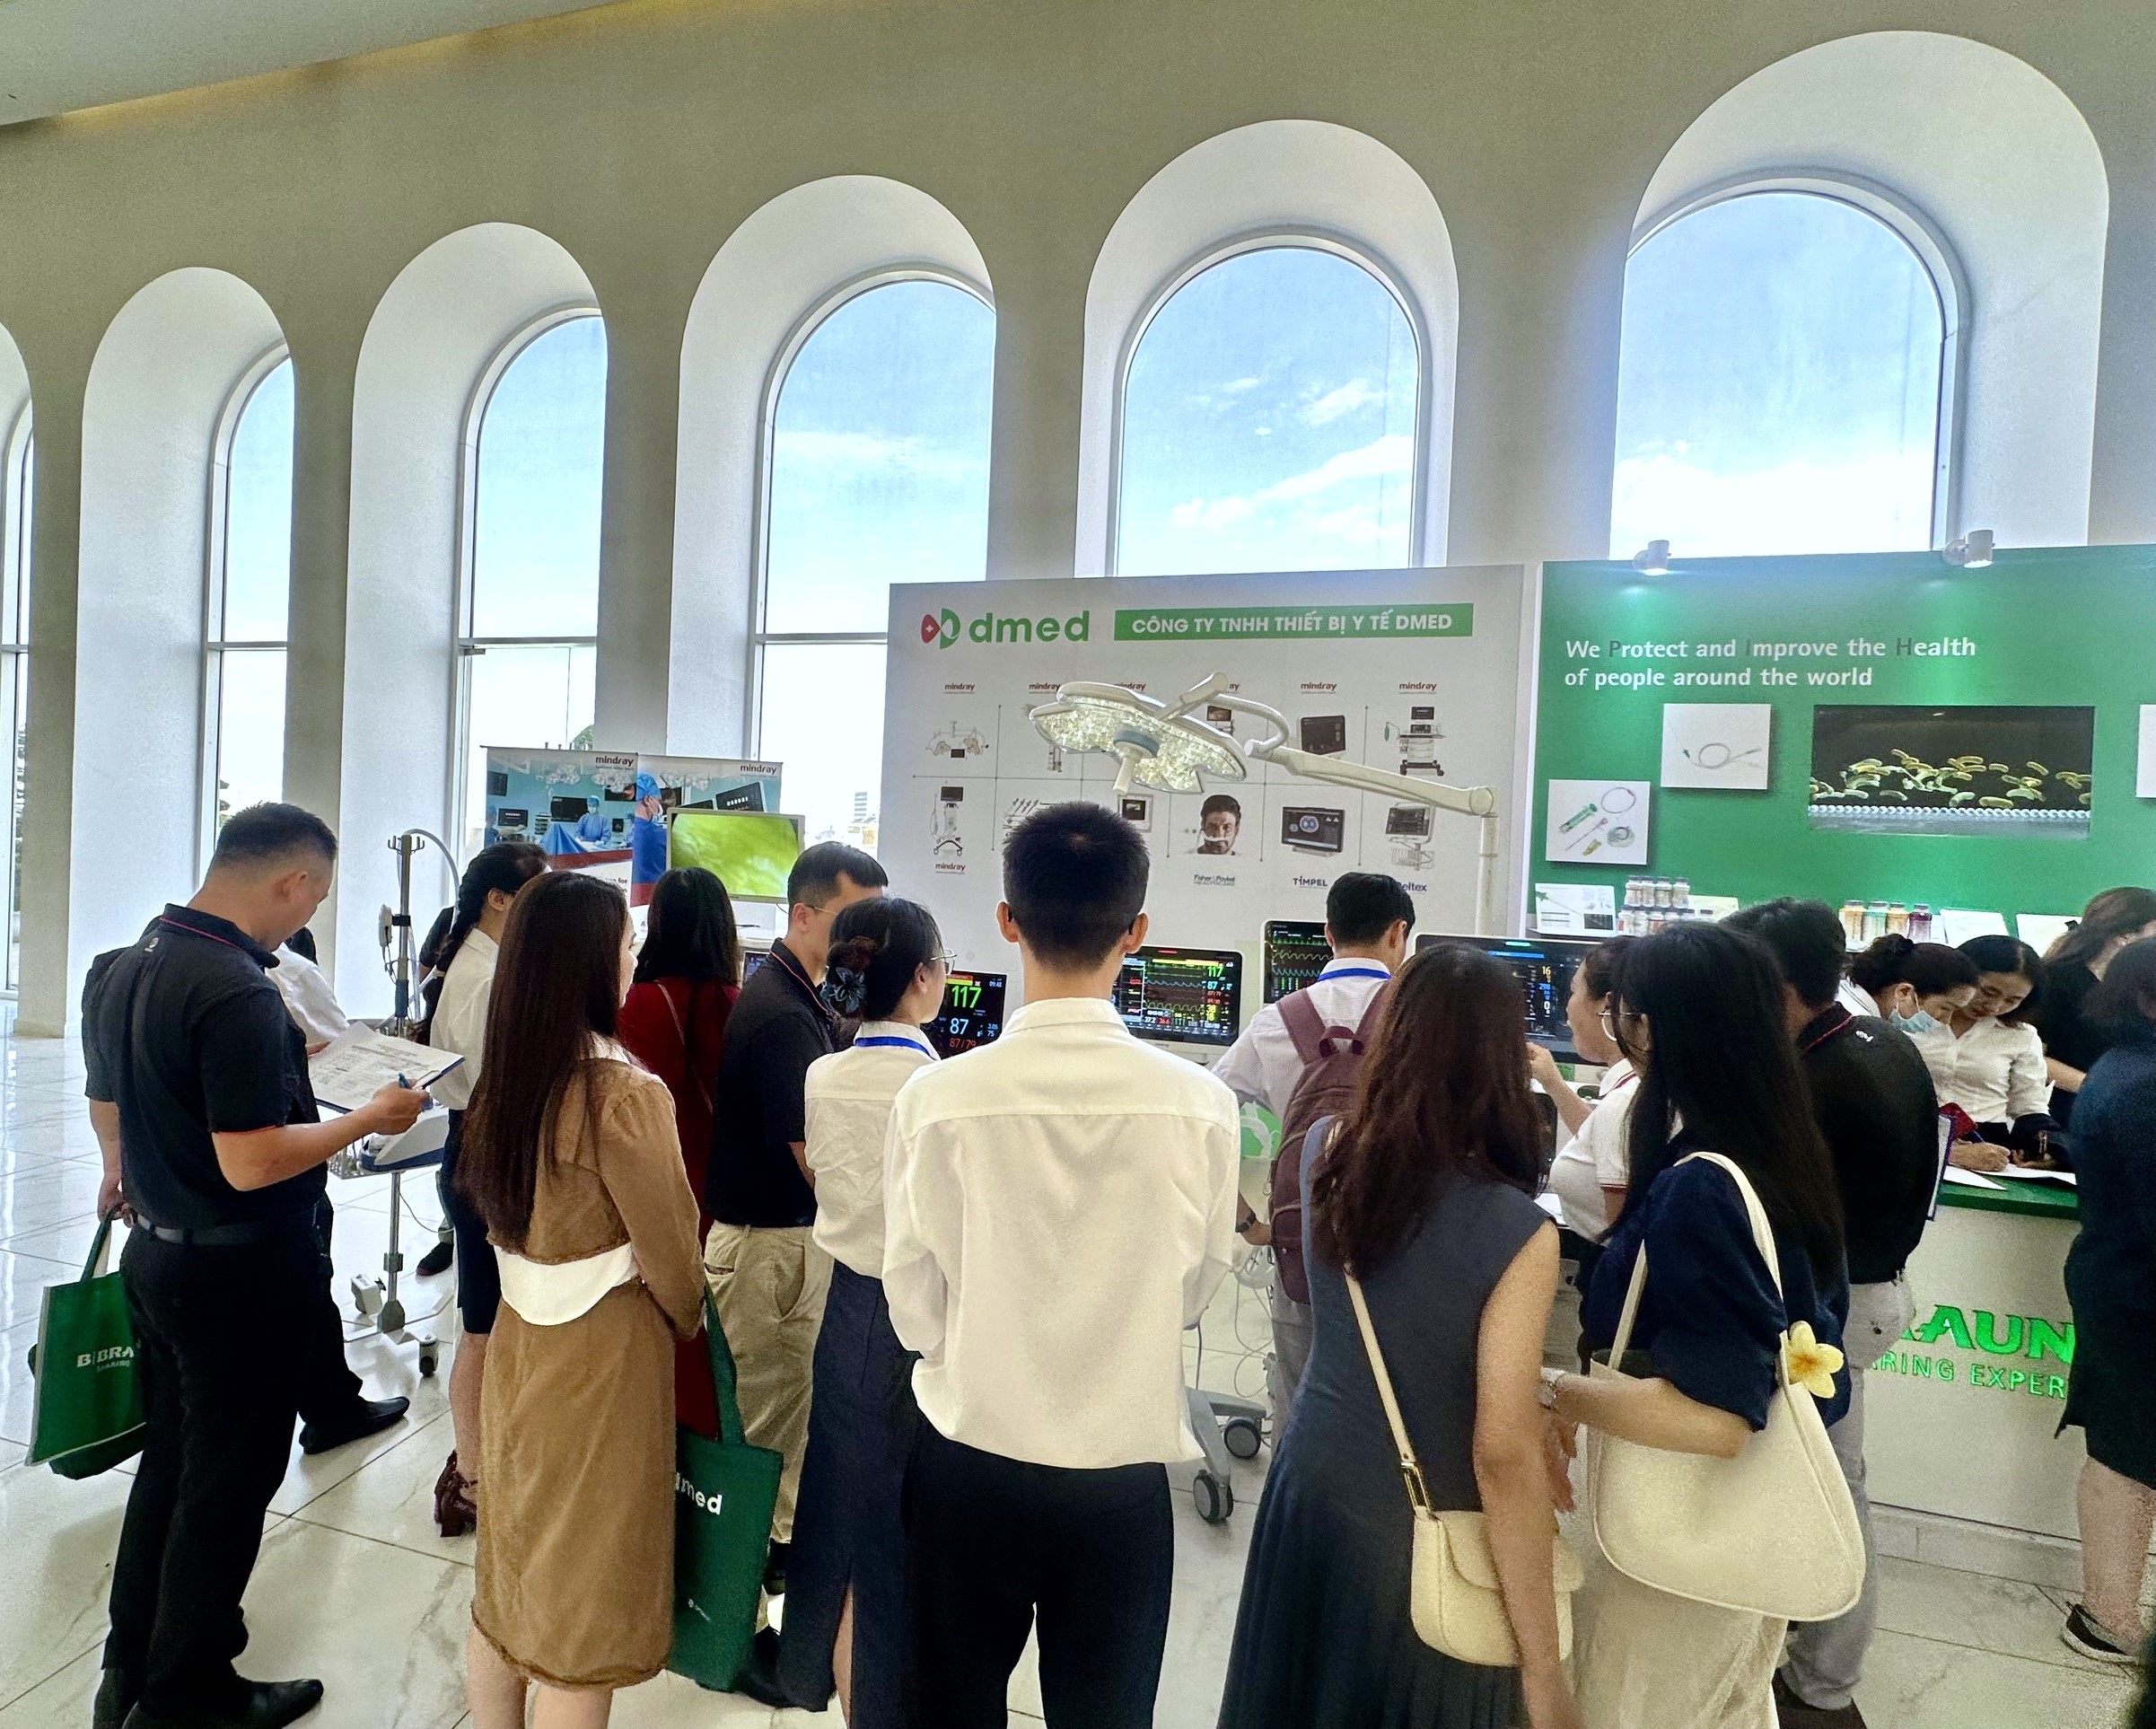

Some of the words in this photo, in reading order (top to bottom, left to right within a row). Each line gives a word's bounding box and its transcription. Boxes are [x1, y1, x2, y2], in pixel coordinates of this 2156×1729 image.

[968, 610, 1090, 644] dmed
[1131, 616, 1188, 634] CÔNG
[1194, 618, 1214, 632] TY
[1220, 617, 1269, 632] TNHH
[1275, 610, 1323, 631] THIẾT
[1328, 616, 1345, 635] BỊ
[1352, 615, 1365, 631] Y
[1370, 610, 1393, 630] TẾ
[1396, 614, 1452, 630] DMED
[1565, 640, 1600, 658] We
[1608, 640, 1688, 658] Protect
[1696, 638, 1736, 657] and
[1746, 638, 1837, 662] Improve
[1847, 637, 1886, 656] the
[1896, 636, 1976, 656] Health
[944, 682, 976, 691] mindray
[1301, 682, 1337, 691] mindray
[1399, 682, 1437, 691] mindray
[1564, 668, 1590, 686] of
[1595, 668, 1665, 690] people
[1673, 668, 1751, 686] around
[1762, 667, 1797, 686] the
[1807, 667, 1872, 686] world
[595, 756, 634, 767] mindray
[740, 764, 777, 775] mindray
[935, 863, 966, 872] mindray
[1401, 882, 1427, 891] eltex
[951, 985, 982, 1008] 117
[950, 1017, 969, 1035] 87
[1899, 1304, 2076, 1365] AUN
[97, 1346, 135, 1363] BRA
[1871, 1349, 1955, 1381] RING
[1970, 1363, 2066, 1399] EXPER
